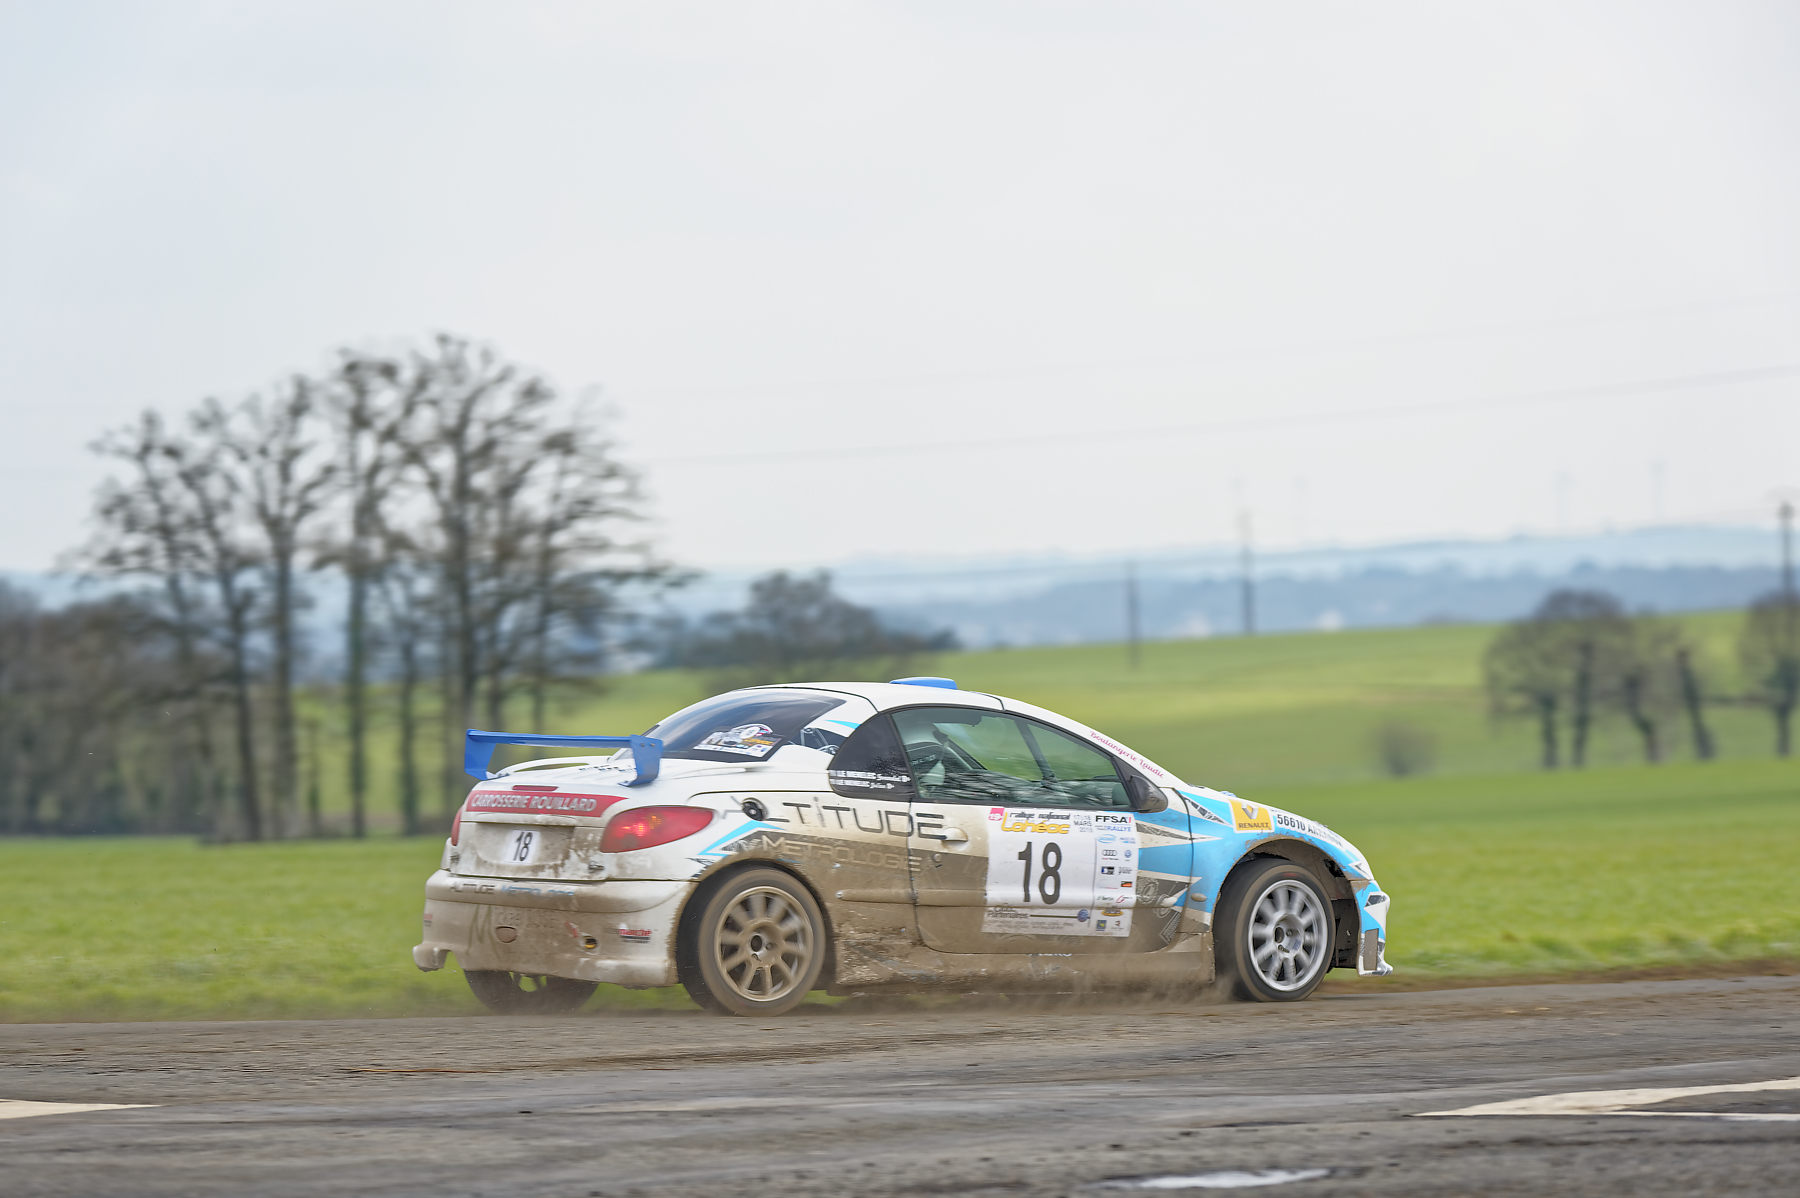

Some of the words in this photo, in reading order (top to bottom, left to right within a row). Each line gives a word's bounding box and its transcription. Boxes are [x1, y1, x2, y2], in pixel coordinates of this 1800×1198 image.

[1090, 730, 1136, 761] Boulangerie
[471, 794, 530, 808] CARROSSERIE
[529, 796, 597, 811] ROUILLARD
[1095, 815, 1128, 824] FFSA
[1277, 814, 1306, 832] 56610
[513, 831, 533, 861] 18
[1018, 841, 1062, 905] 18
